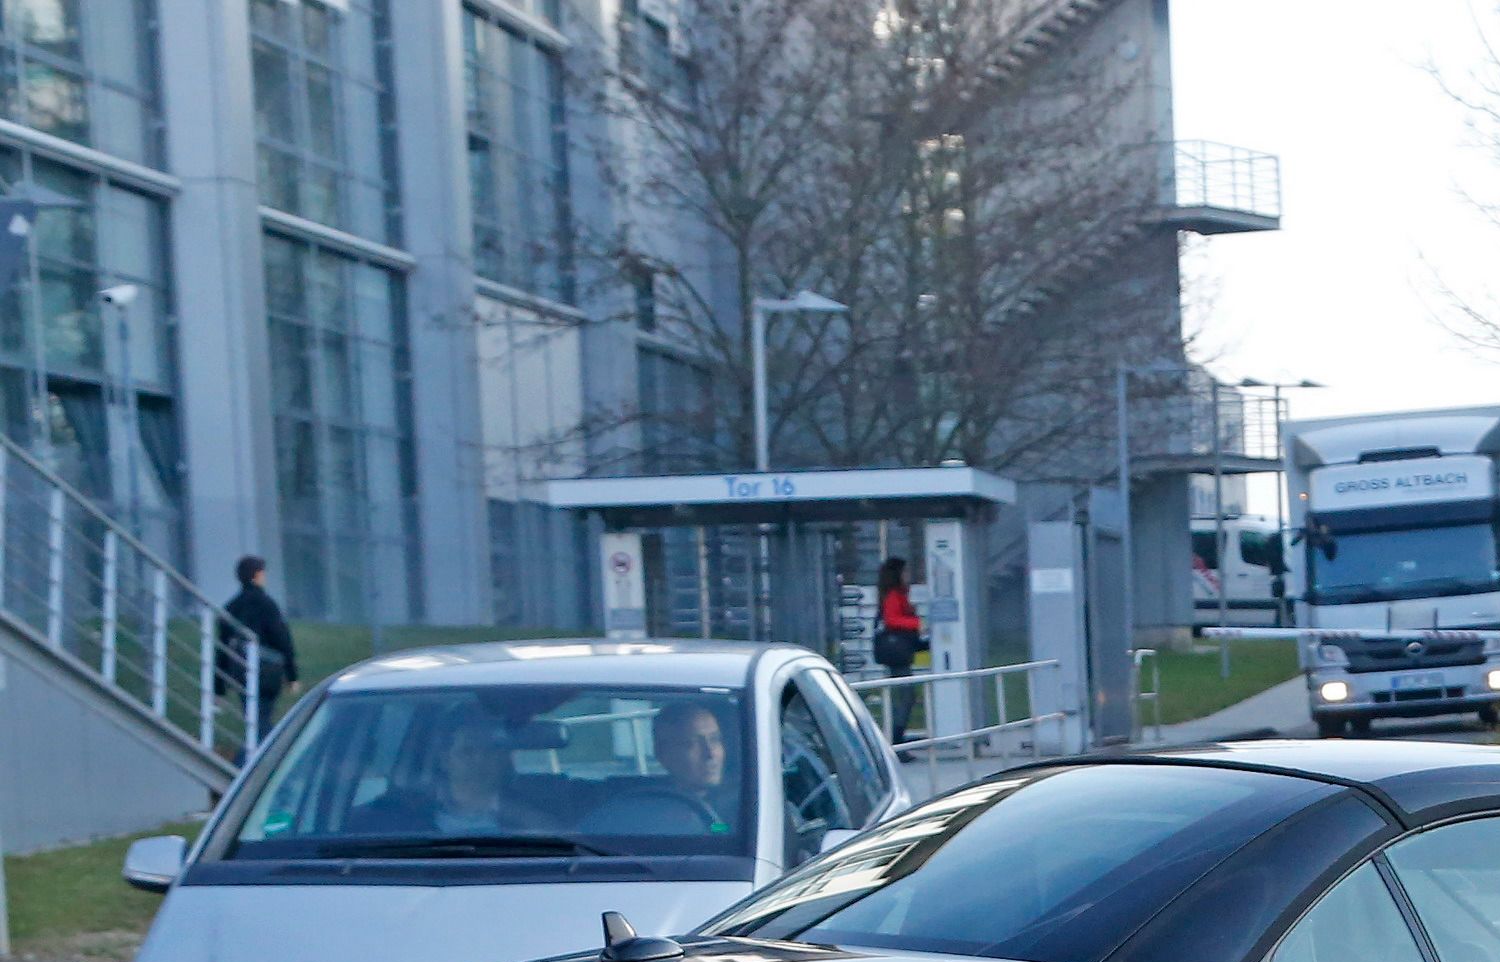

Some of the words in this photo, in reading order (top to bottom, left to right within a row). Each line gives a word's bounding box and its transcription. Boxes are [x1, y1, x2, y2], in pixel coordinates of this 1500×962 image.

[725, 476, 761, 497] Tor
[771, 475, 795, 496] 16
[1334, 477, 1390, 494] GROSS
[1394, 472, 1468, 488] ALTBACH
